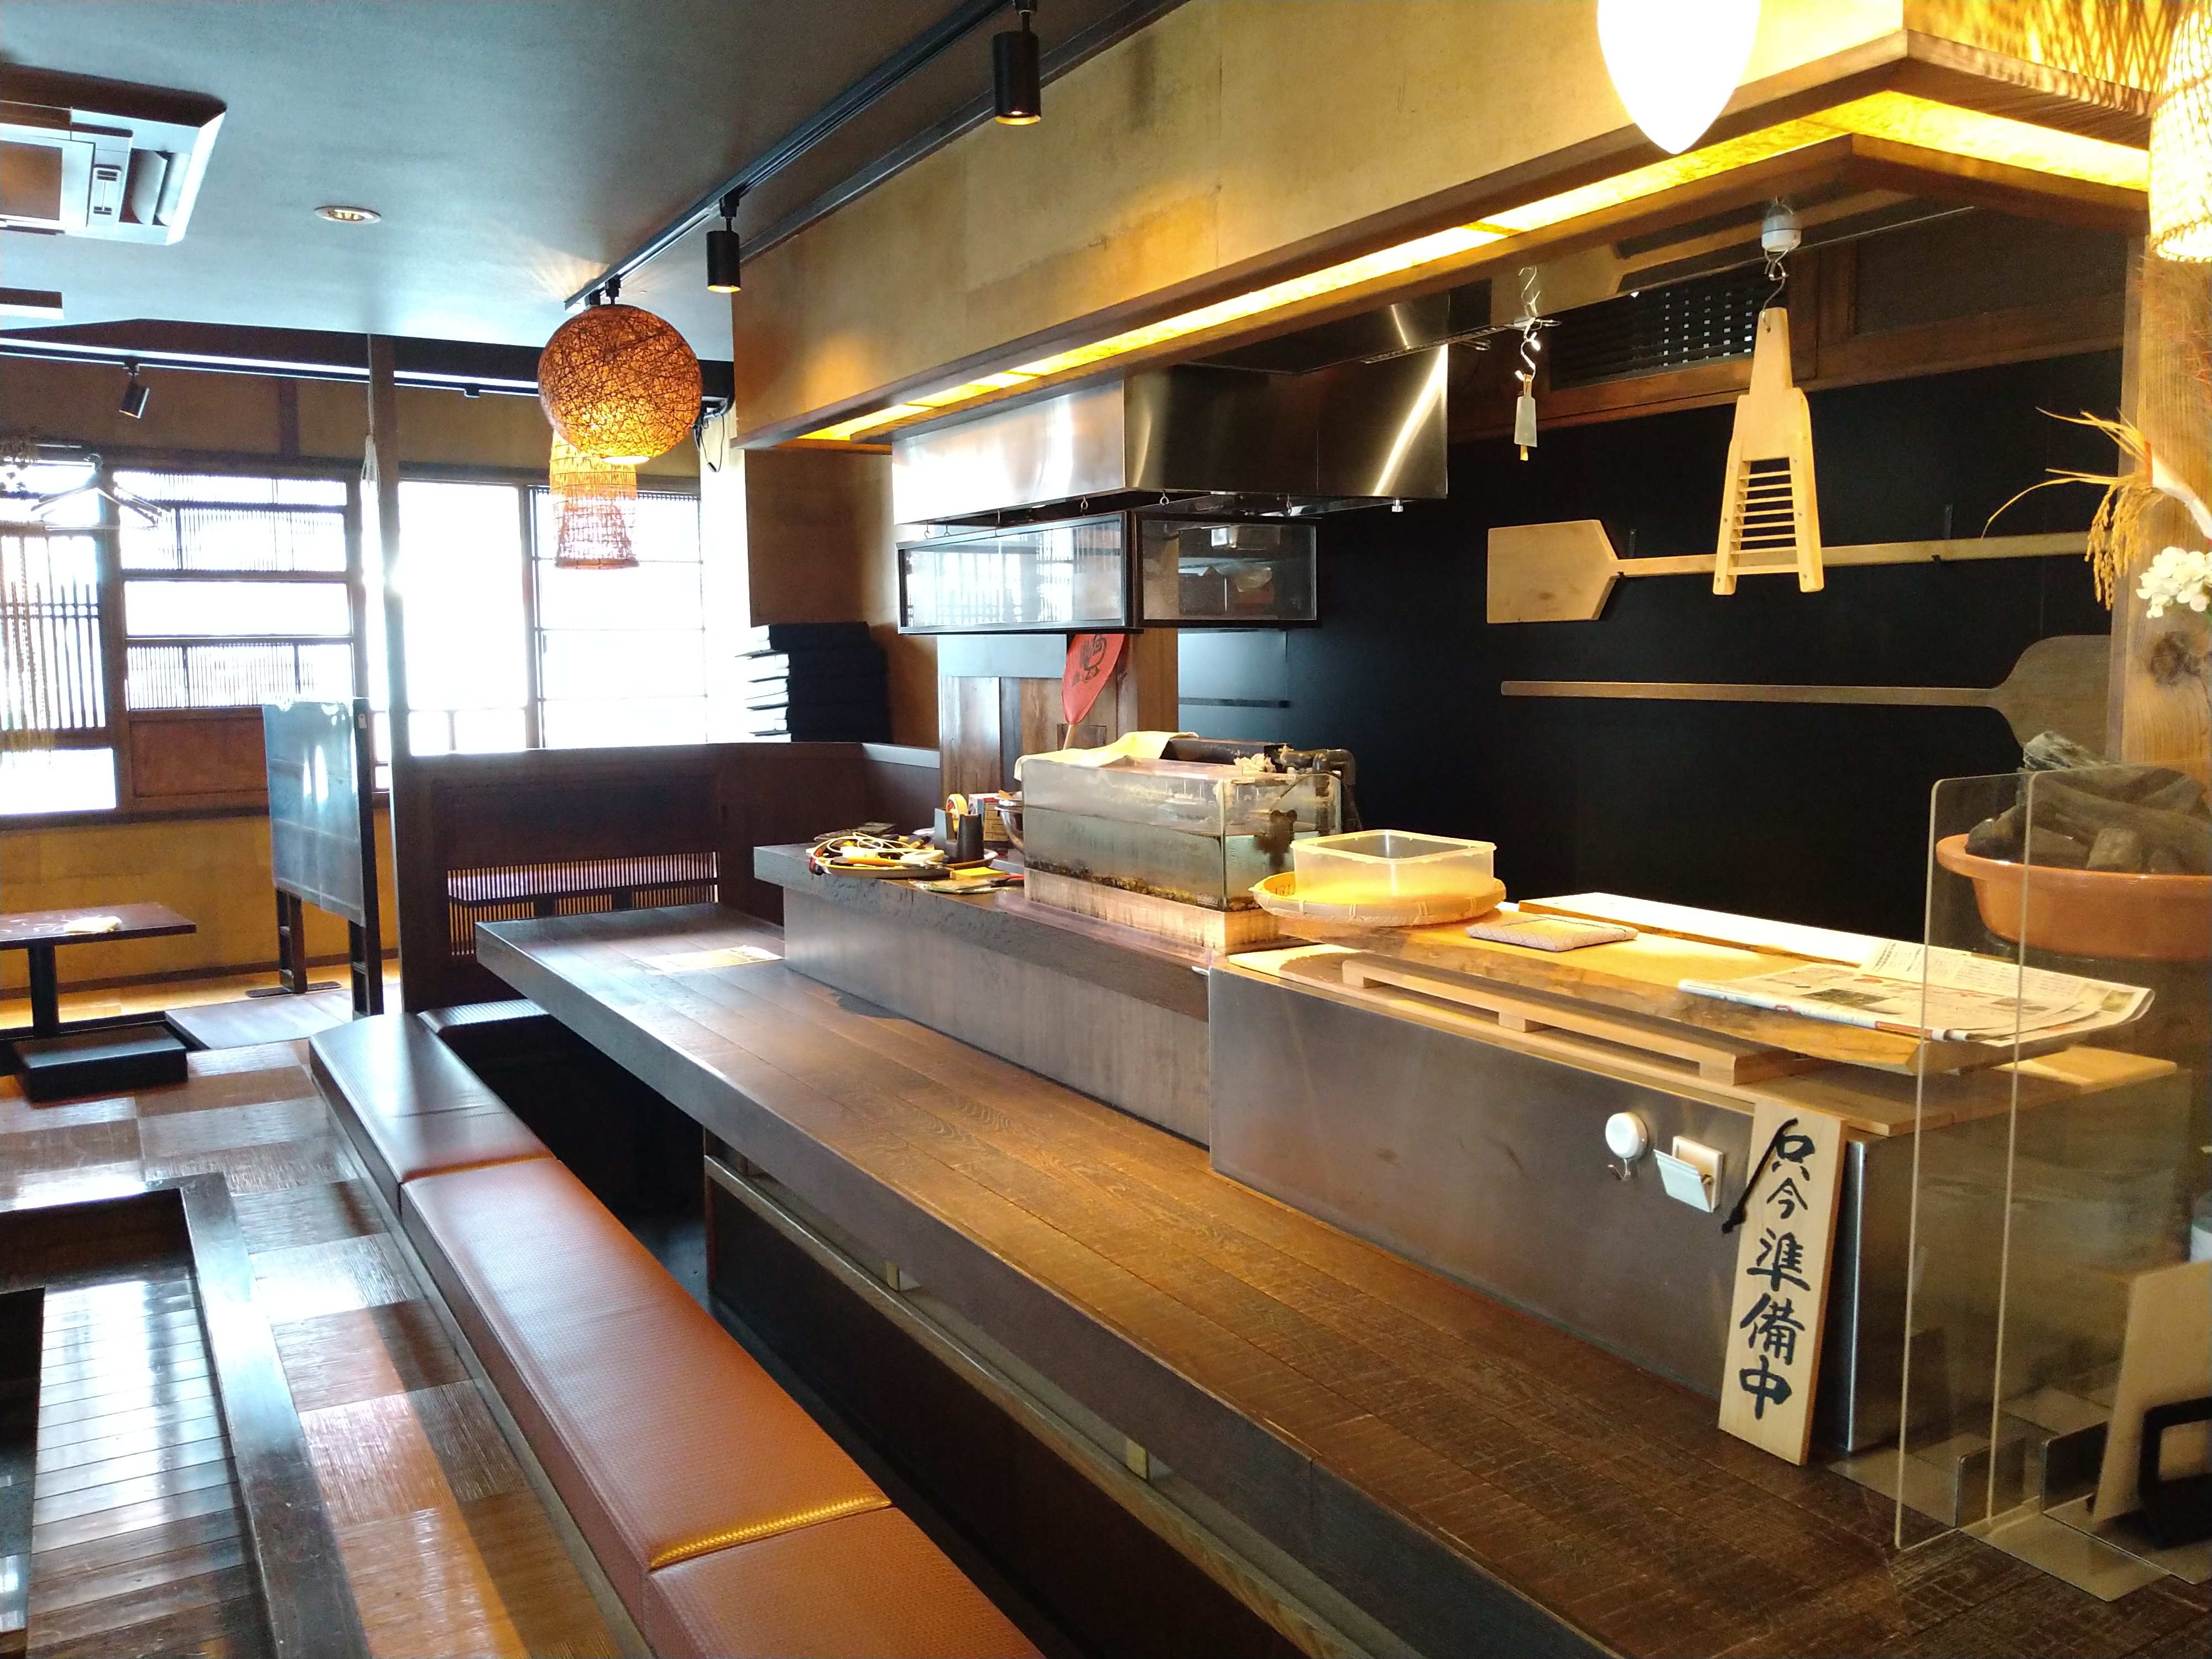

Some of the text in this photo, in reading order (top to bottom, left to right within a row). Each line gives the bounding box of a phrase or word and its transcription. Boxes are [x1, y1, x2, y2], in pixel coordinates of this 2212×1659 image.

[1740, 1134, 1815, 1421] 只今準備中
